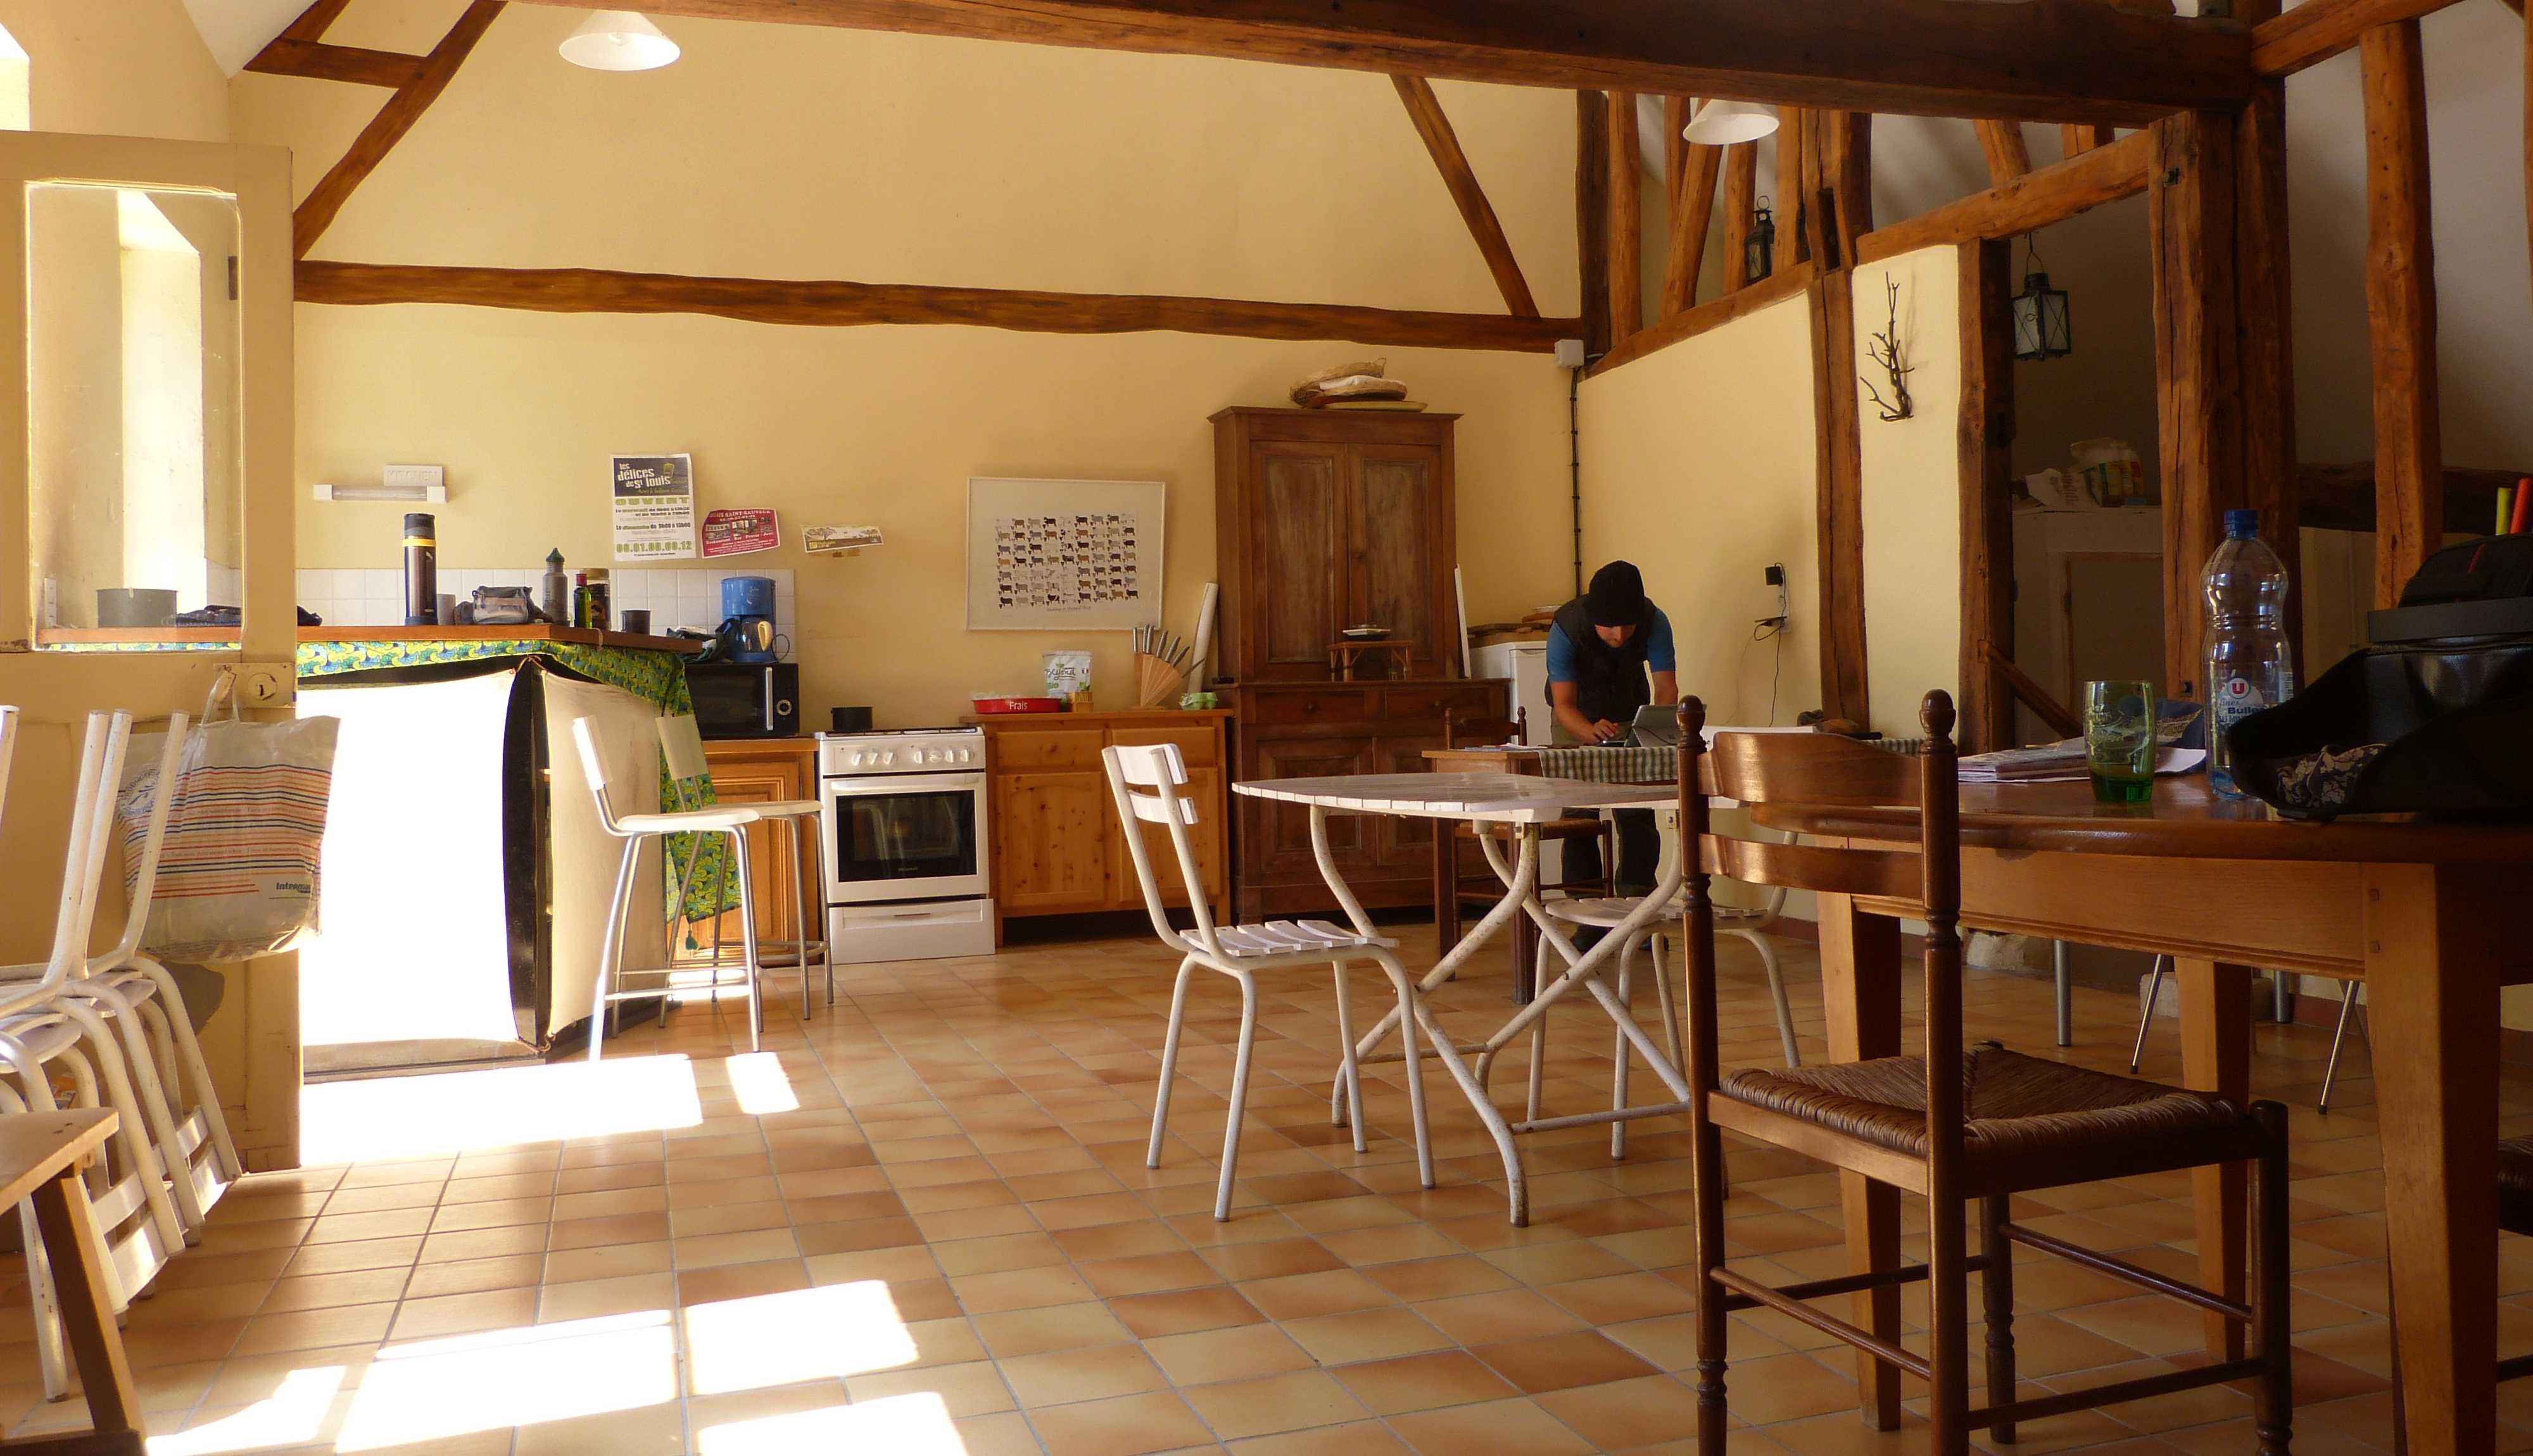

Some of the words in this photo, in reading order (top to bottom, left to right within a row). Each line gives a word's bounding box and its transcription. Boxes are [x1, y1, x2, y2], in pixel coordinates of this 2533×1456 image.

[617, 468, 655, 481] délices
[616, 497, 689, 505] OUVERT
[2232, 683, 2245, 694] U
[1009, 701, 1028, 710] Frais
